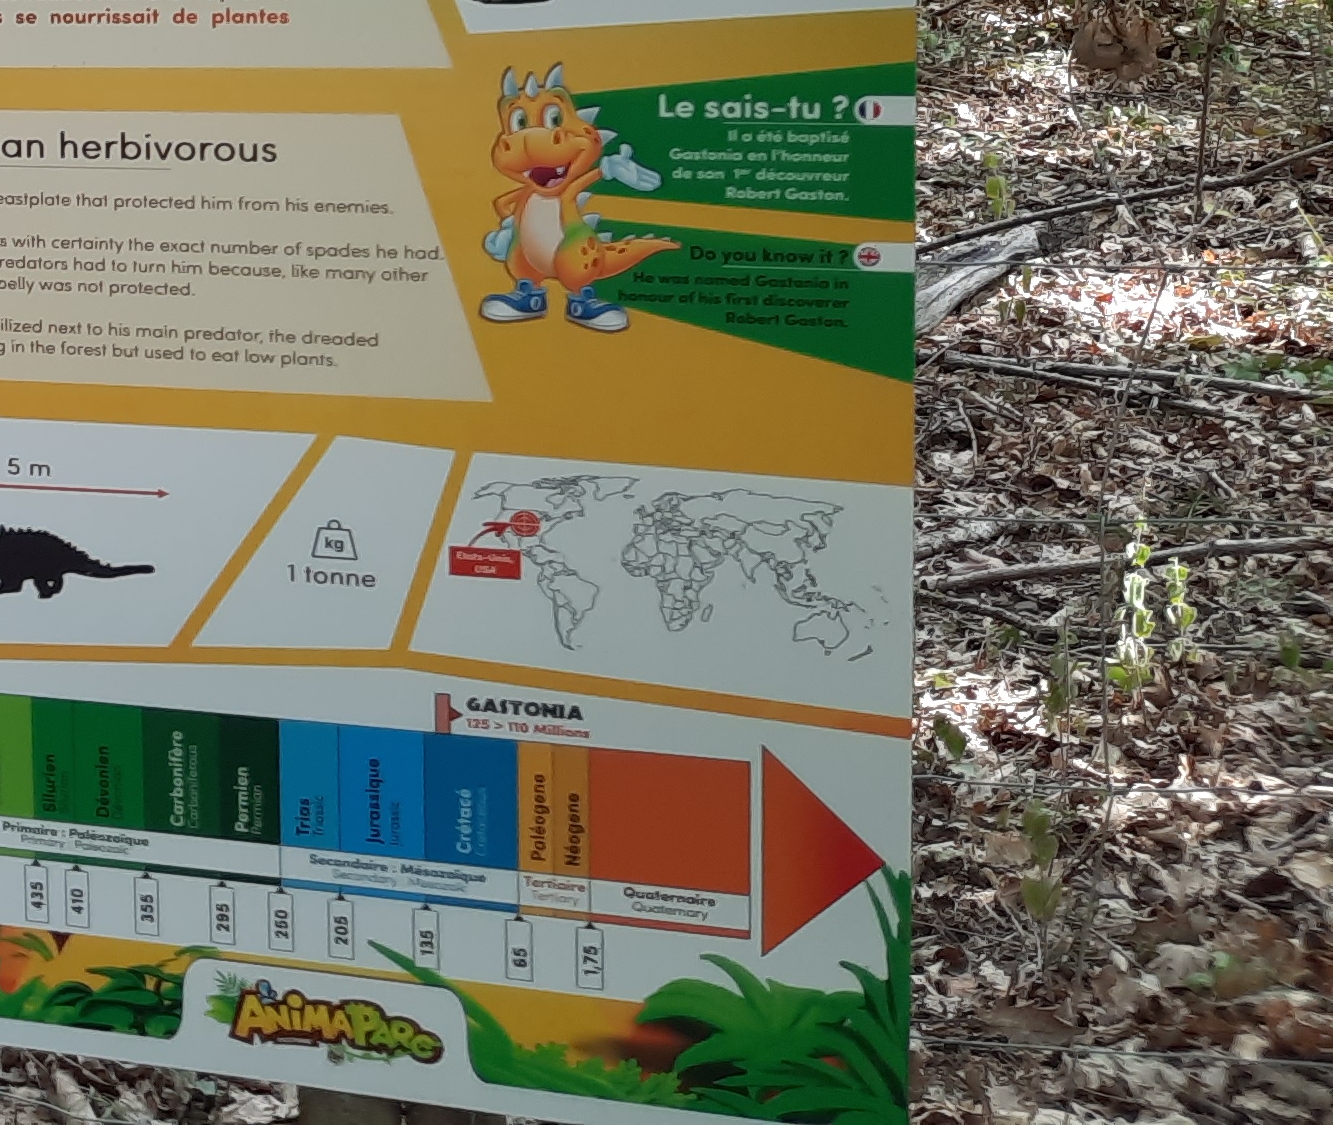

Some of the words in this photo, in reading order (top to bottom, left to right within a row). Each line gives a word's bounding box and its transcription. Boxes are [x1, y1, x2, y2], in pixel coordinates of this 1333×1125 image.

[15, 12, 37, 25] se
[50, 7, 159, 25] nourrissait
[172, 7, 198, 24] de
[212, 7, 288, 29] plantes
[659, 94, 695, 118] Le
[705, 94, 821, 120] sais-tu
[832, 95, 849, 120] ?
[60, 130, 277, 162] herbivorous
[76, 193, 108, 208] that
[114, 195, 196, 212] protected
[201, 195, 233, 211] him
[238, 196, 280, 211] from
[285, 197, 309, 212] his
[314, 202, 393, 215] enemies.
[690, 245, 717, 261] Do
[721, 250, 757, 265] you
[762, 247, 815, 264] know
[820, 249, 833, 264] it
[839, 249, 849, 265] ?
[48, 322, 82, 335] next
[86, 322, 103, 336] to
[108, 322, 131, 337] his
[135, 325, 178, 339] main
[184, 326, 264, 344] predator,
[269, 328, 296, 344] the
[301, 330, 379, 348] dreaded
[6, 458, 21, 476] 5
[30, 461, 51, 478] m
[323, 535, 344, 555] kg
[287, 564, 296, 582] 1
[303, 567, 376, 589] tonne
[466, 697, 584, 721] GASTONIA
[95, 745, 110, 818] Dévonien
[233, 766, 249, 833] Permien
[364, 757, 384, 845] Jurassique
[295, 797, 310, 836] Trias
[455, 787, 473, 854] Crétacé
[30, 881, 47, 910] 435
[70, 888, 84, 915] 410
[216, 903, 230, 934] 295
